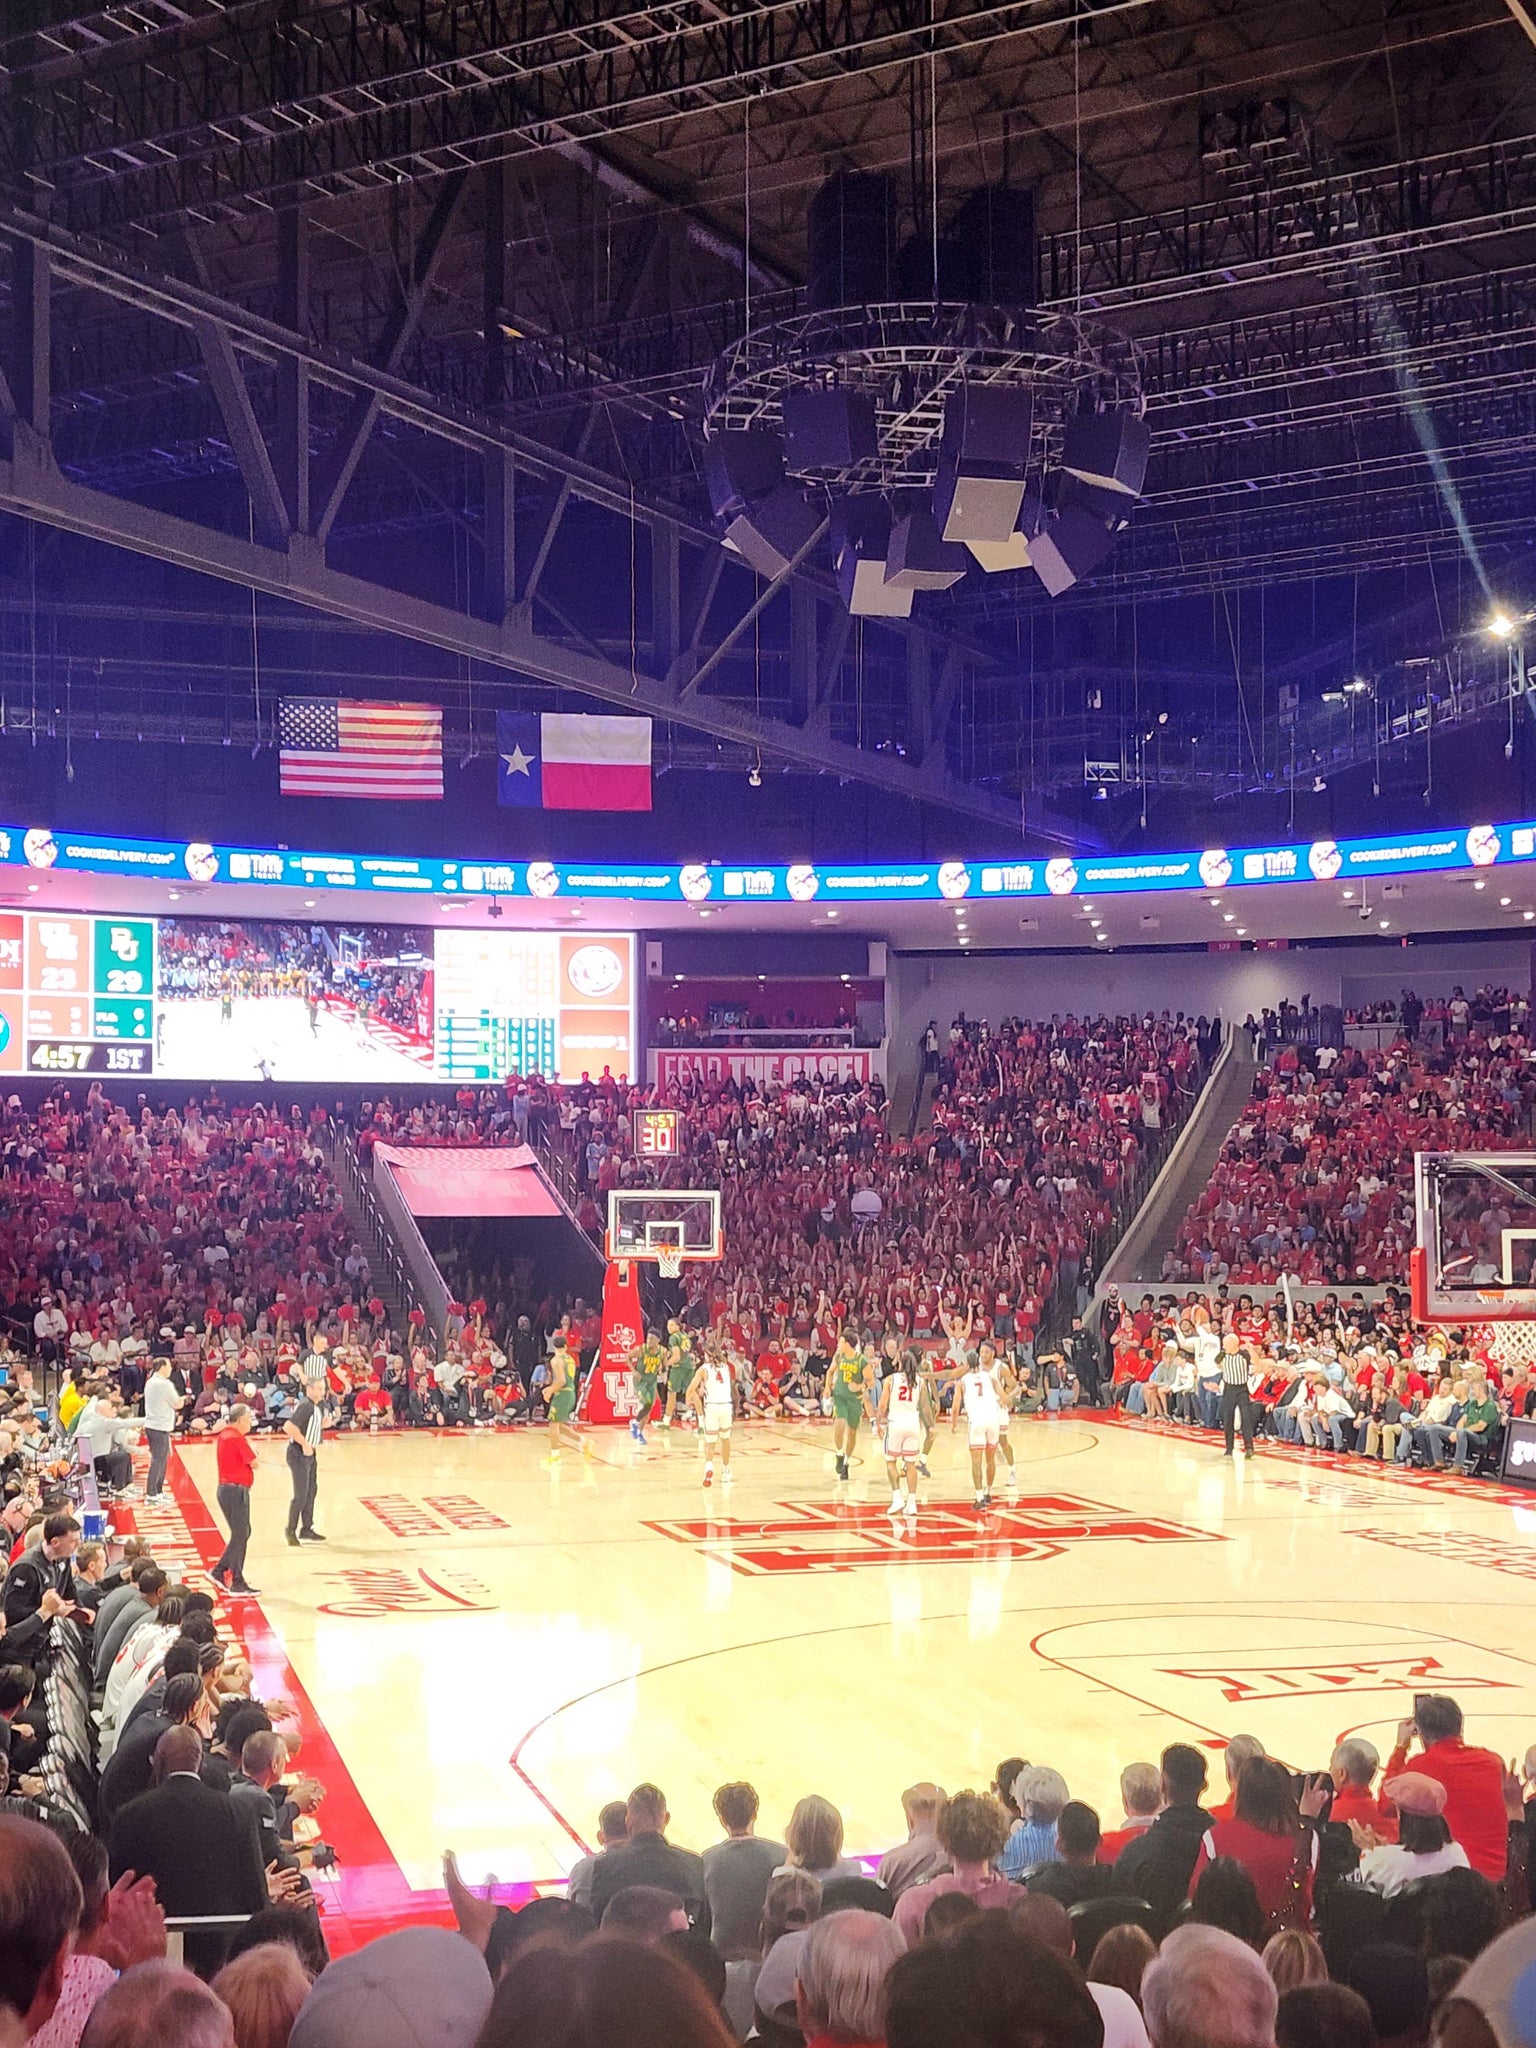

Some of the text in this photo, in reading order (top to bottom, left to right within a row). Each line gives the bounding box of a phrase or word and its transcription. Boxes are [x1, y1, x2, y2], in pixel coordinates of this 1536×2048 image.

[111, 928, 139, 961] BU
[40, 967, 77, 990] 23
[107, 970, 143, 992] 29
[32, 1044, 143, 1069] 4:57 1ST
[646, 1114, 675, 1128] 4:57
[643, 1128, 671, 1151] 30
[716, 1371, 725, 1384] 4
[603, 1372, 642, 1416] UH
[898, 1386, 913, 1402] 21
[975, 1383, 983, 1397] 7
[357, 1494, 451, 1538] FERTITTA
[421, 1495, 513, 1531] CENTER
[640, 1493, 1236, 1577] UH
